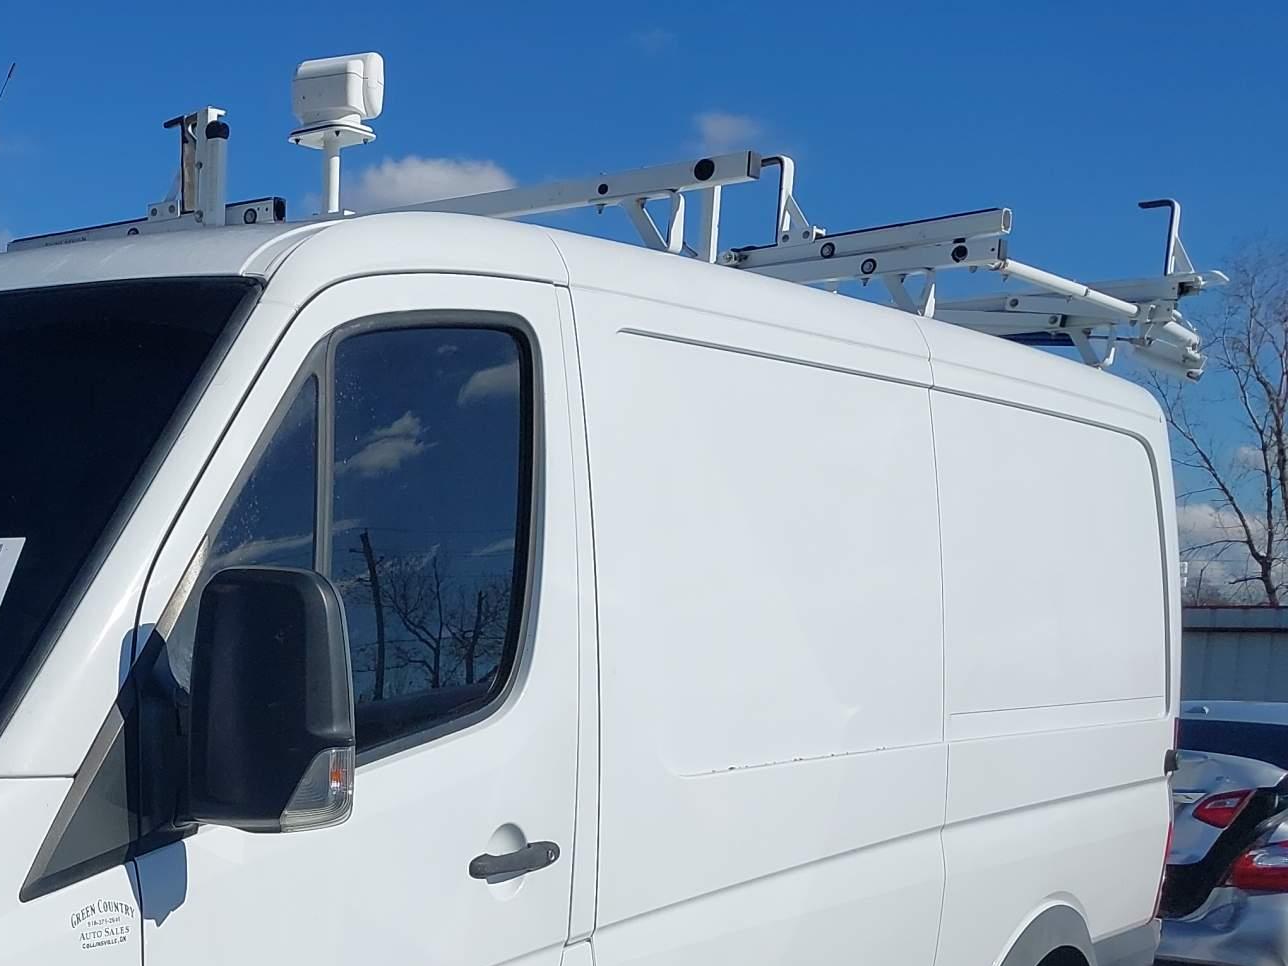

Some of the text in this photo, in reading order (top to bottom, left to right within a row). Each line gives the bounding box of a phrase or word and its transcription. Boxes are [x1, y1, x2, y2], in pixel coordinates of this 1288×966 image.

[70, 899, 135, 928] GREEN COUNTRY
[79, 926, 130, 941] AUTO SALES
